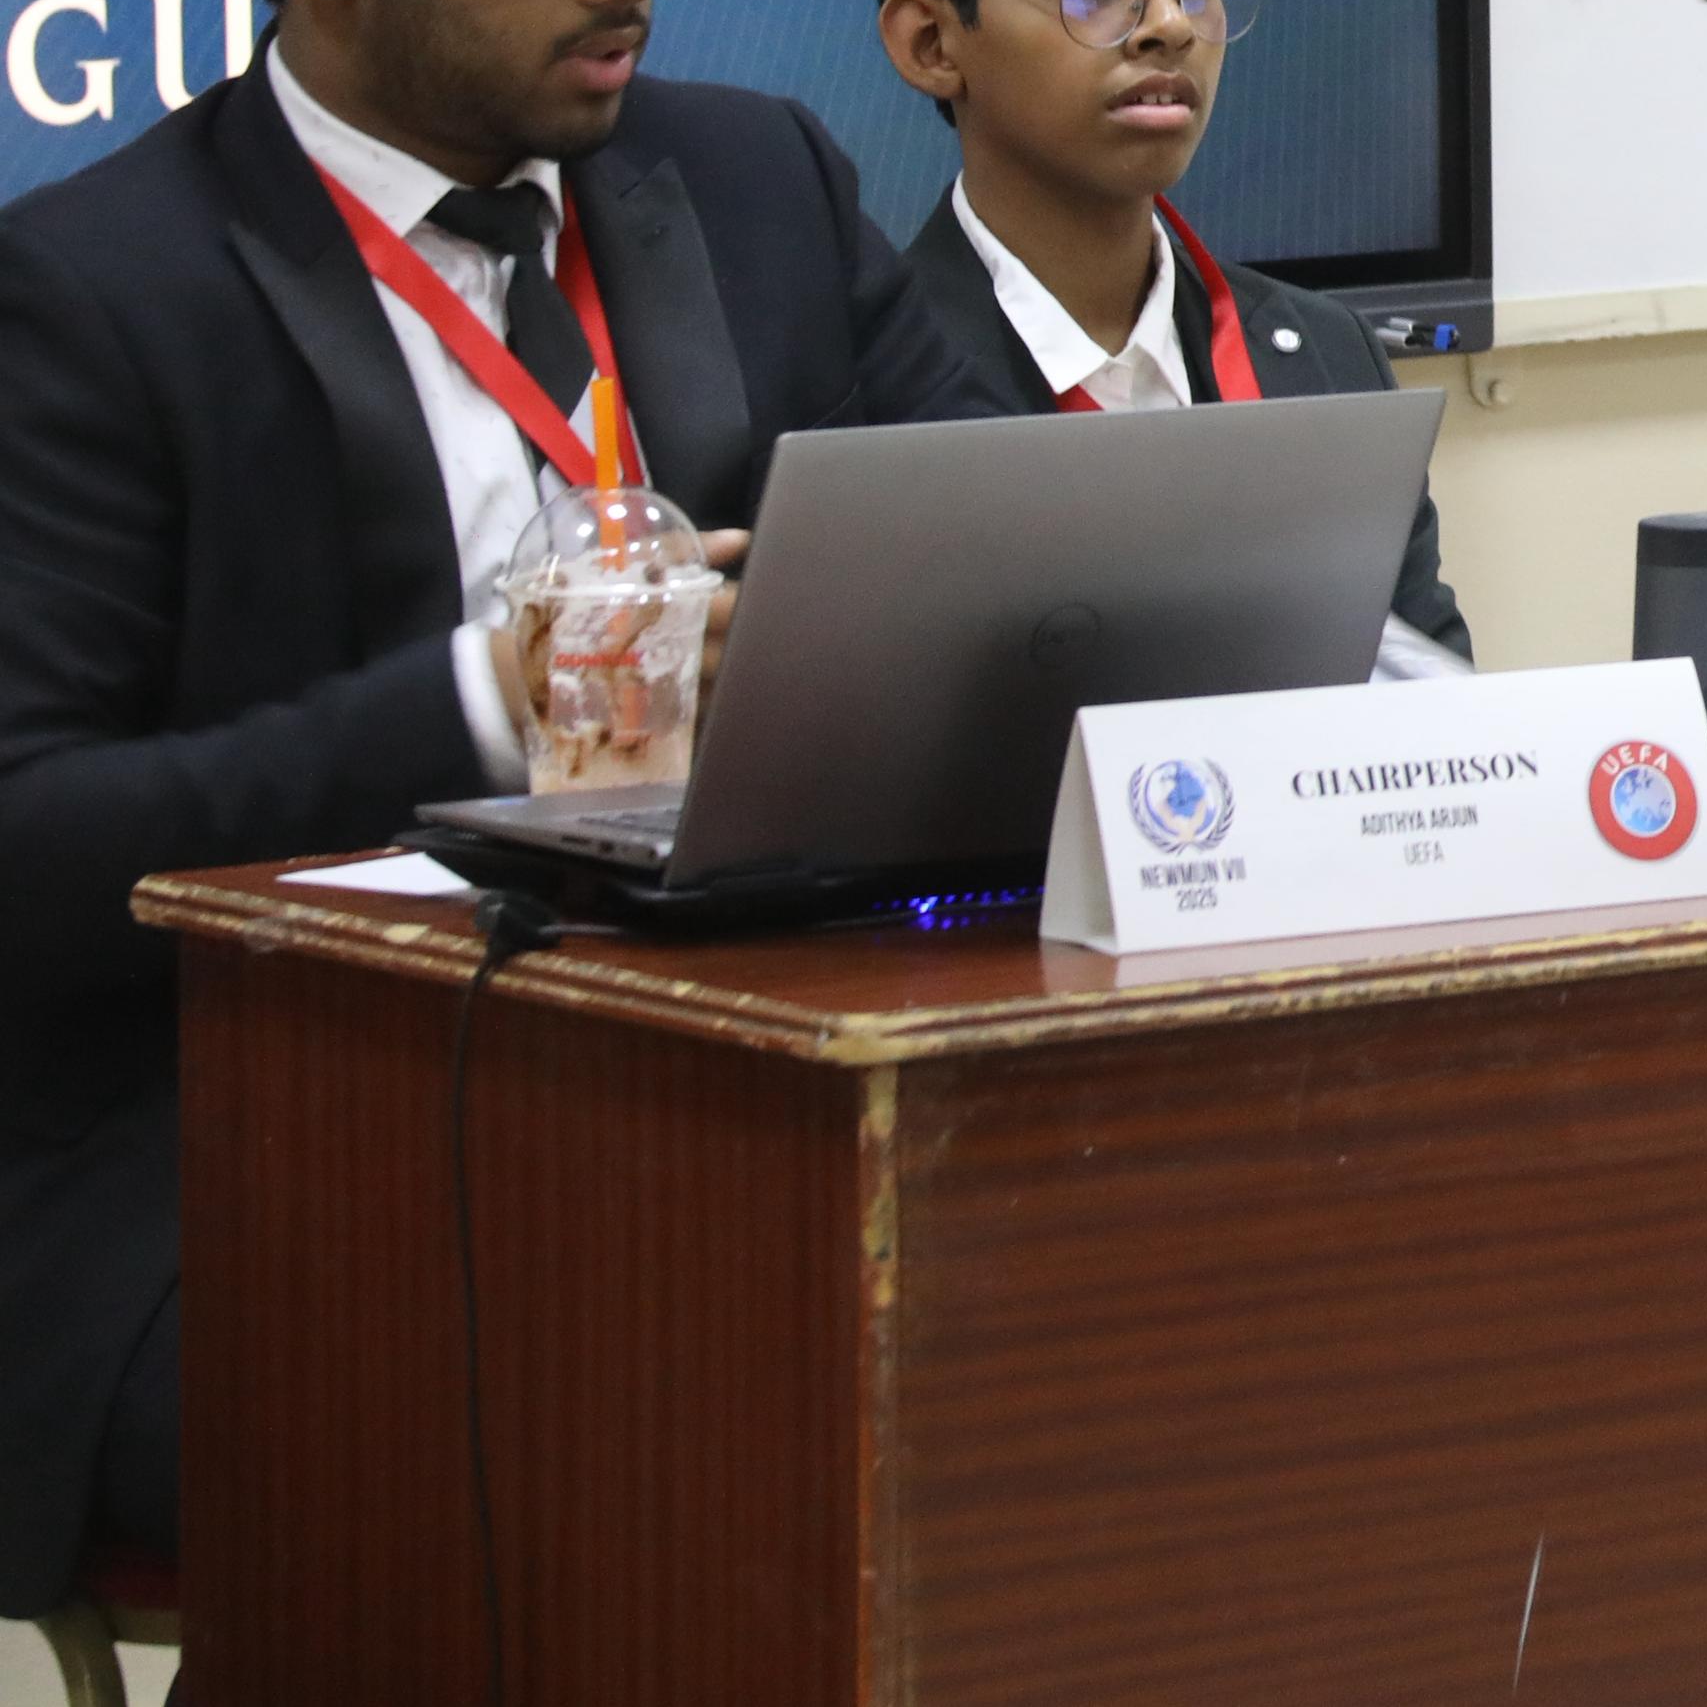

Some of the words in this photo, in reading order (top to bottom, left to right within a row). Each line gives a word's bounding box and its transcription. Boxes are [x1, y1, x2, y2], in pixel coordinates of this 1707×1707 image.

[1291, 750, 1539, 799] CHAIRPERSON
[1601, 744, 1668, 775] UEFA
[1360, 810, 1426, 837] ADITHYA
[1430, 803, 1479, 830] ARJUN
[1403, 840, 1445, 867] UEFA
[1140, 859, 1219, 890] NEWMUN
[1175, 886, 1218, 911] 2025
